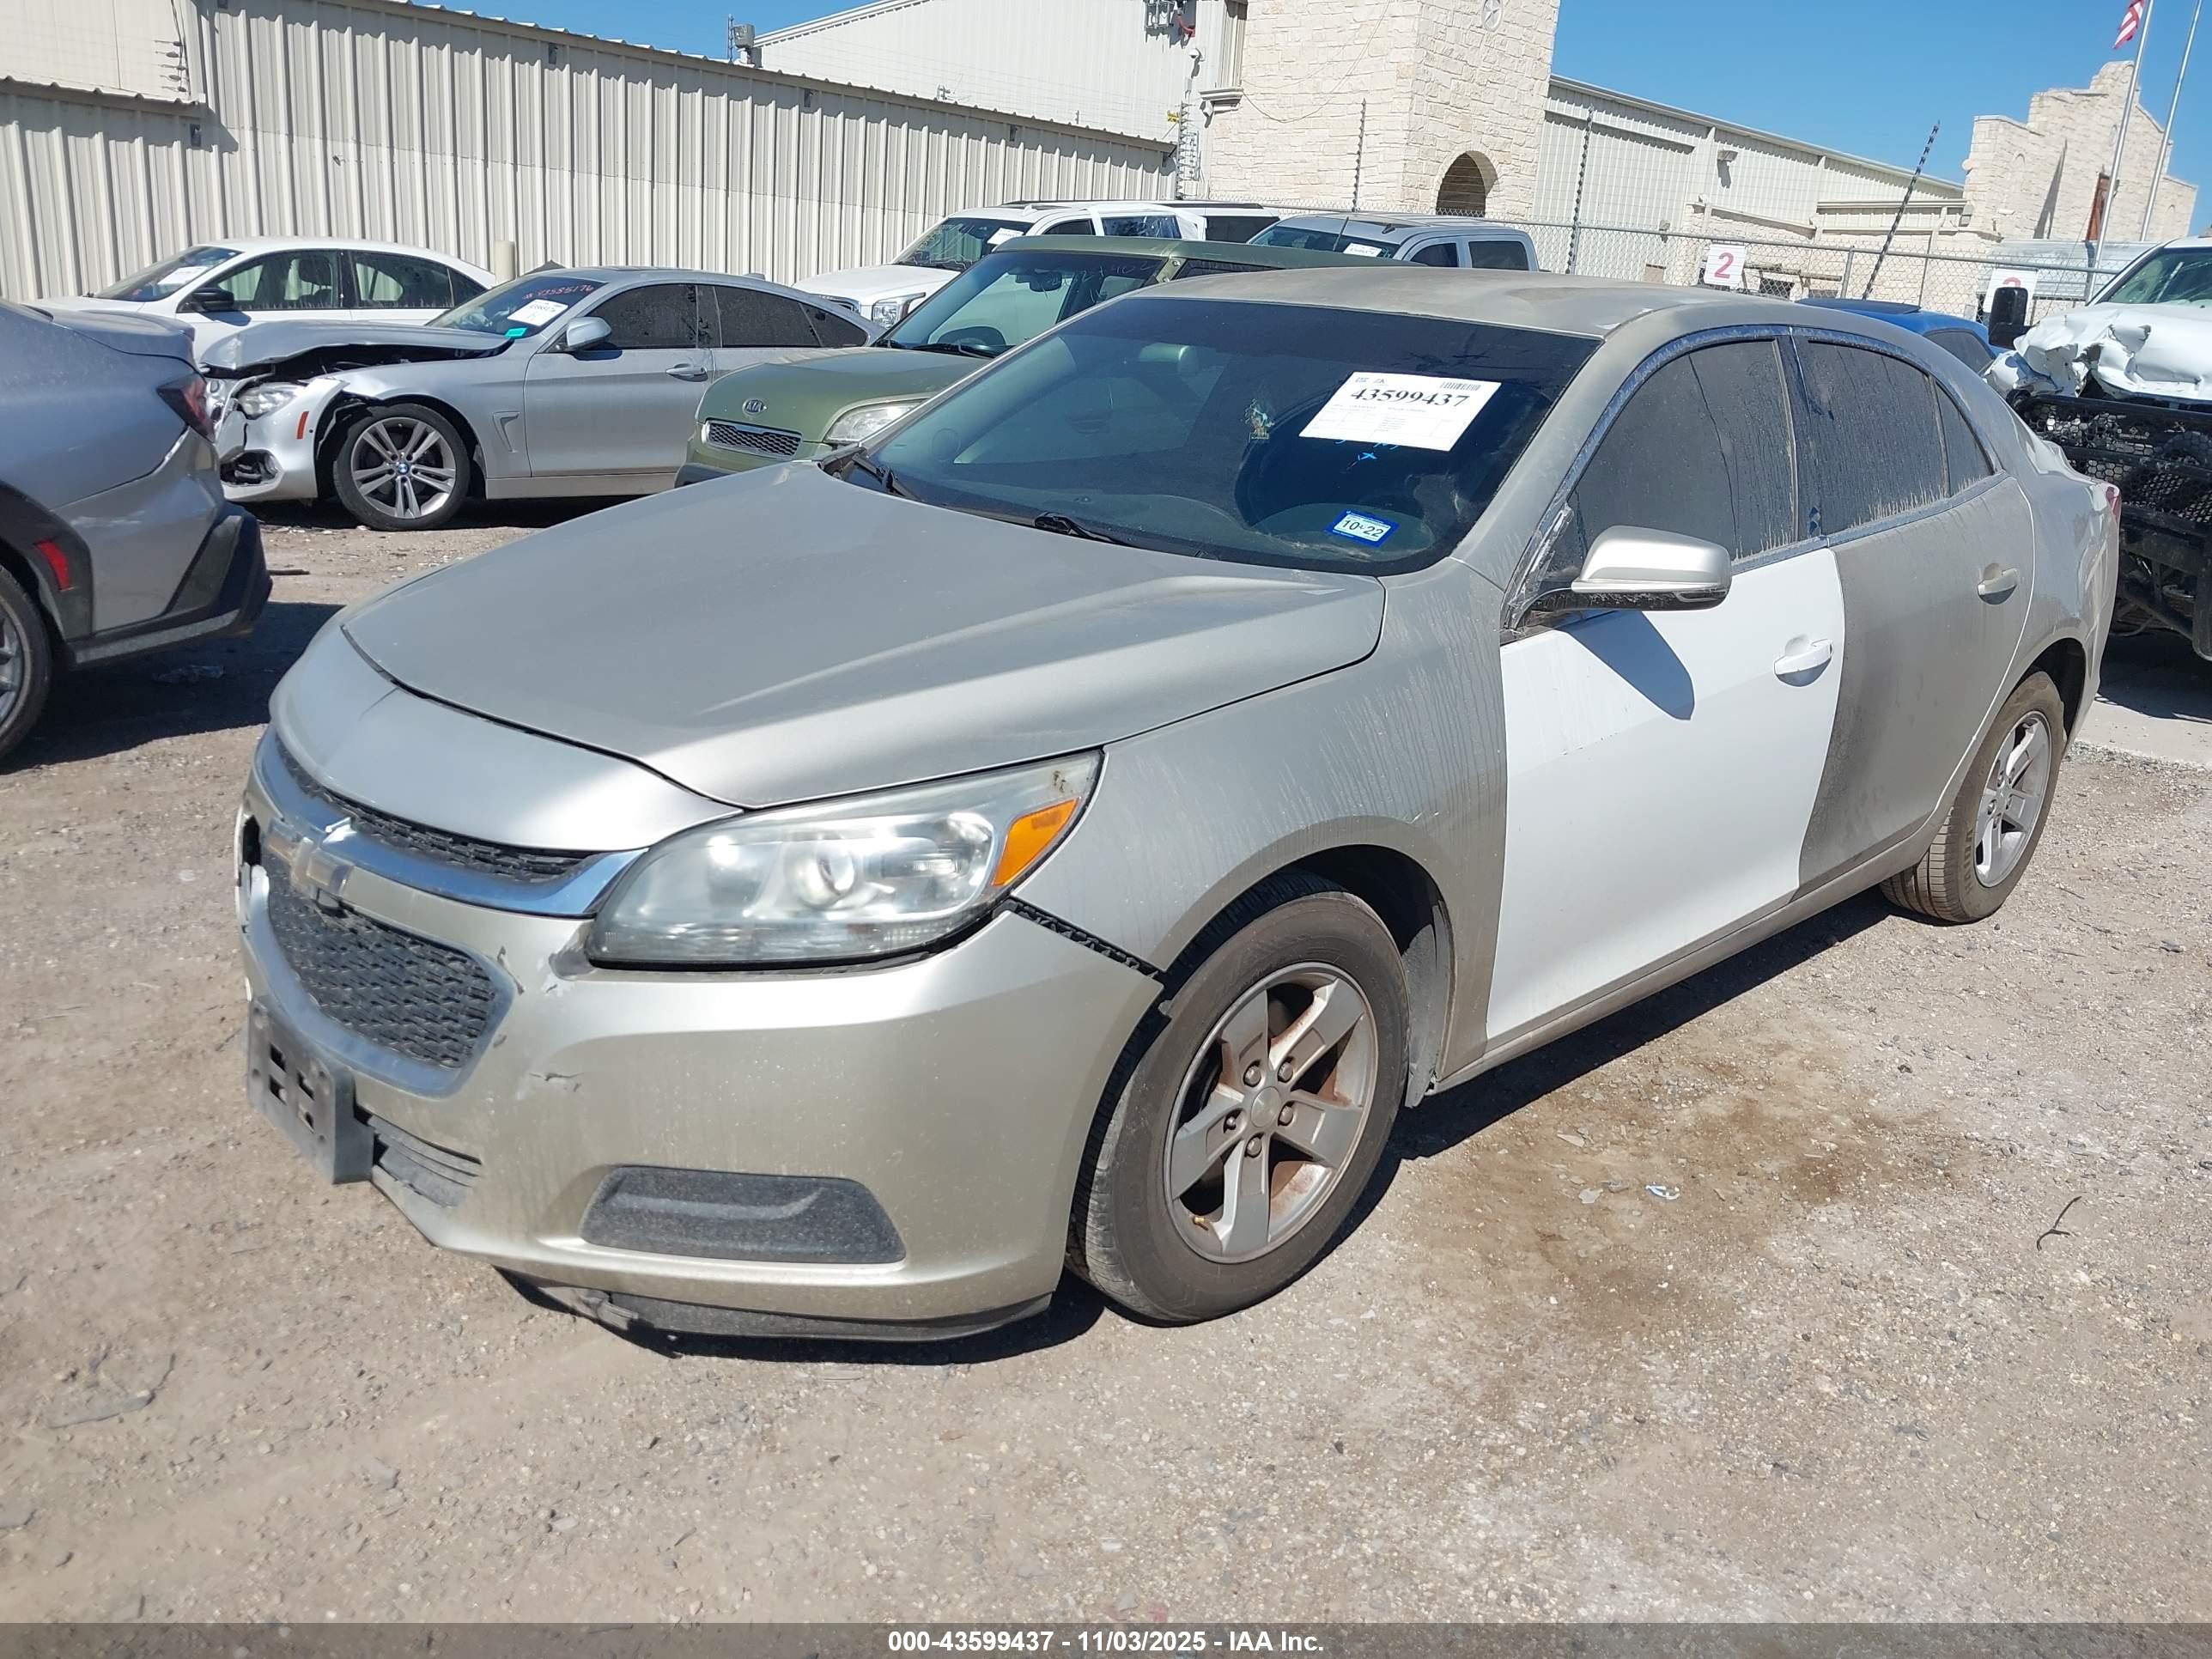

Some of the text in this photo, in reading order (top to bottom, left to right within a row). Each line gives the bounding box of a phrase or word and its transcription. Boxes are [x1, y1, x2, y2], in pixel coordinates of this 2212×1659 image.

[1714, 252, 1734, 279] 2
[1350, 388, 1470, 407] 43599437
[1342, 520, 1384, 538] 10 22
